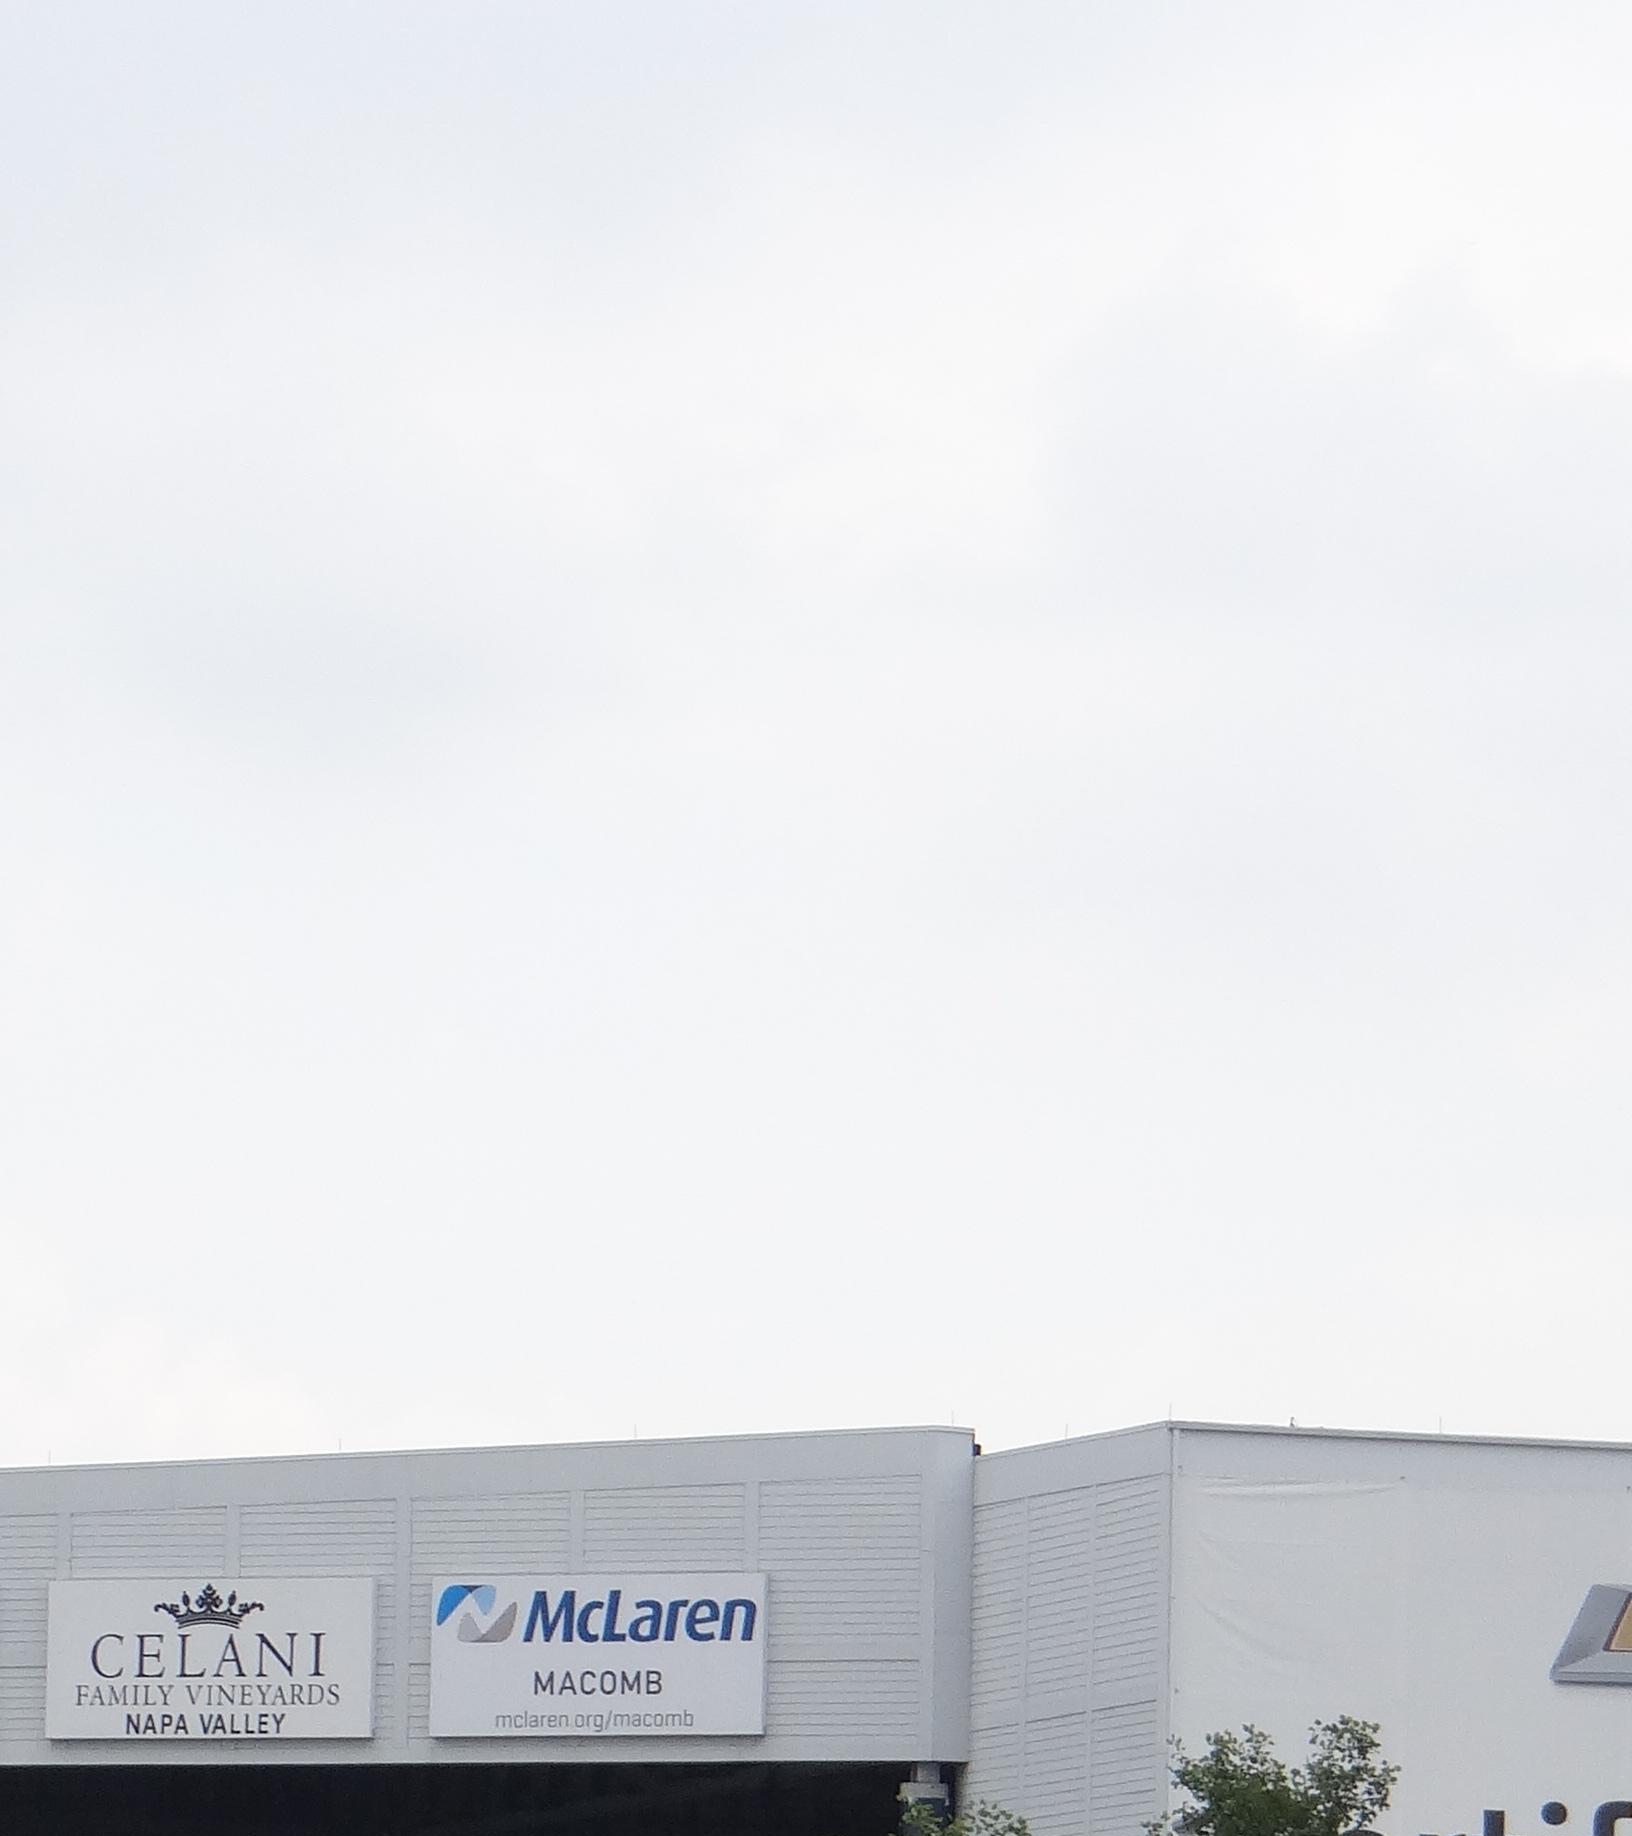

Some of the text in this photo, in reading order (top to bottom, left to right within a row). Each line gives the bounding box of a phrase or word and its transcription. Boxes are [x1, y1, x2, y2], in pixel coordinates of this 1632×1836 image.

[523, 1590, 757, 1643] McLaren
[91, 1632, 326, 1679] CELANI
[76, 1683, 340, 1706] FAMILY VINEYARDS
[534, 1671, 663, 1696] MACOMB
[125, 1713, 286, 1735] NAPA VALLEY
[495, 1709, 695, 1733] mclaren.org/macomb
